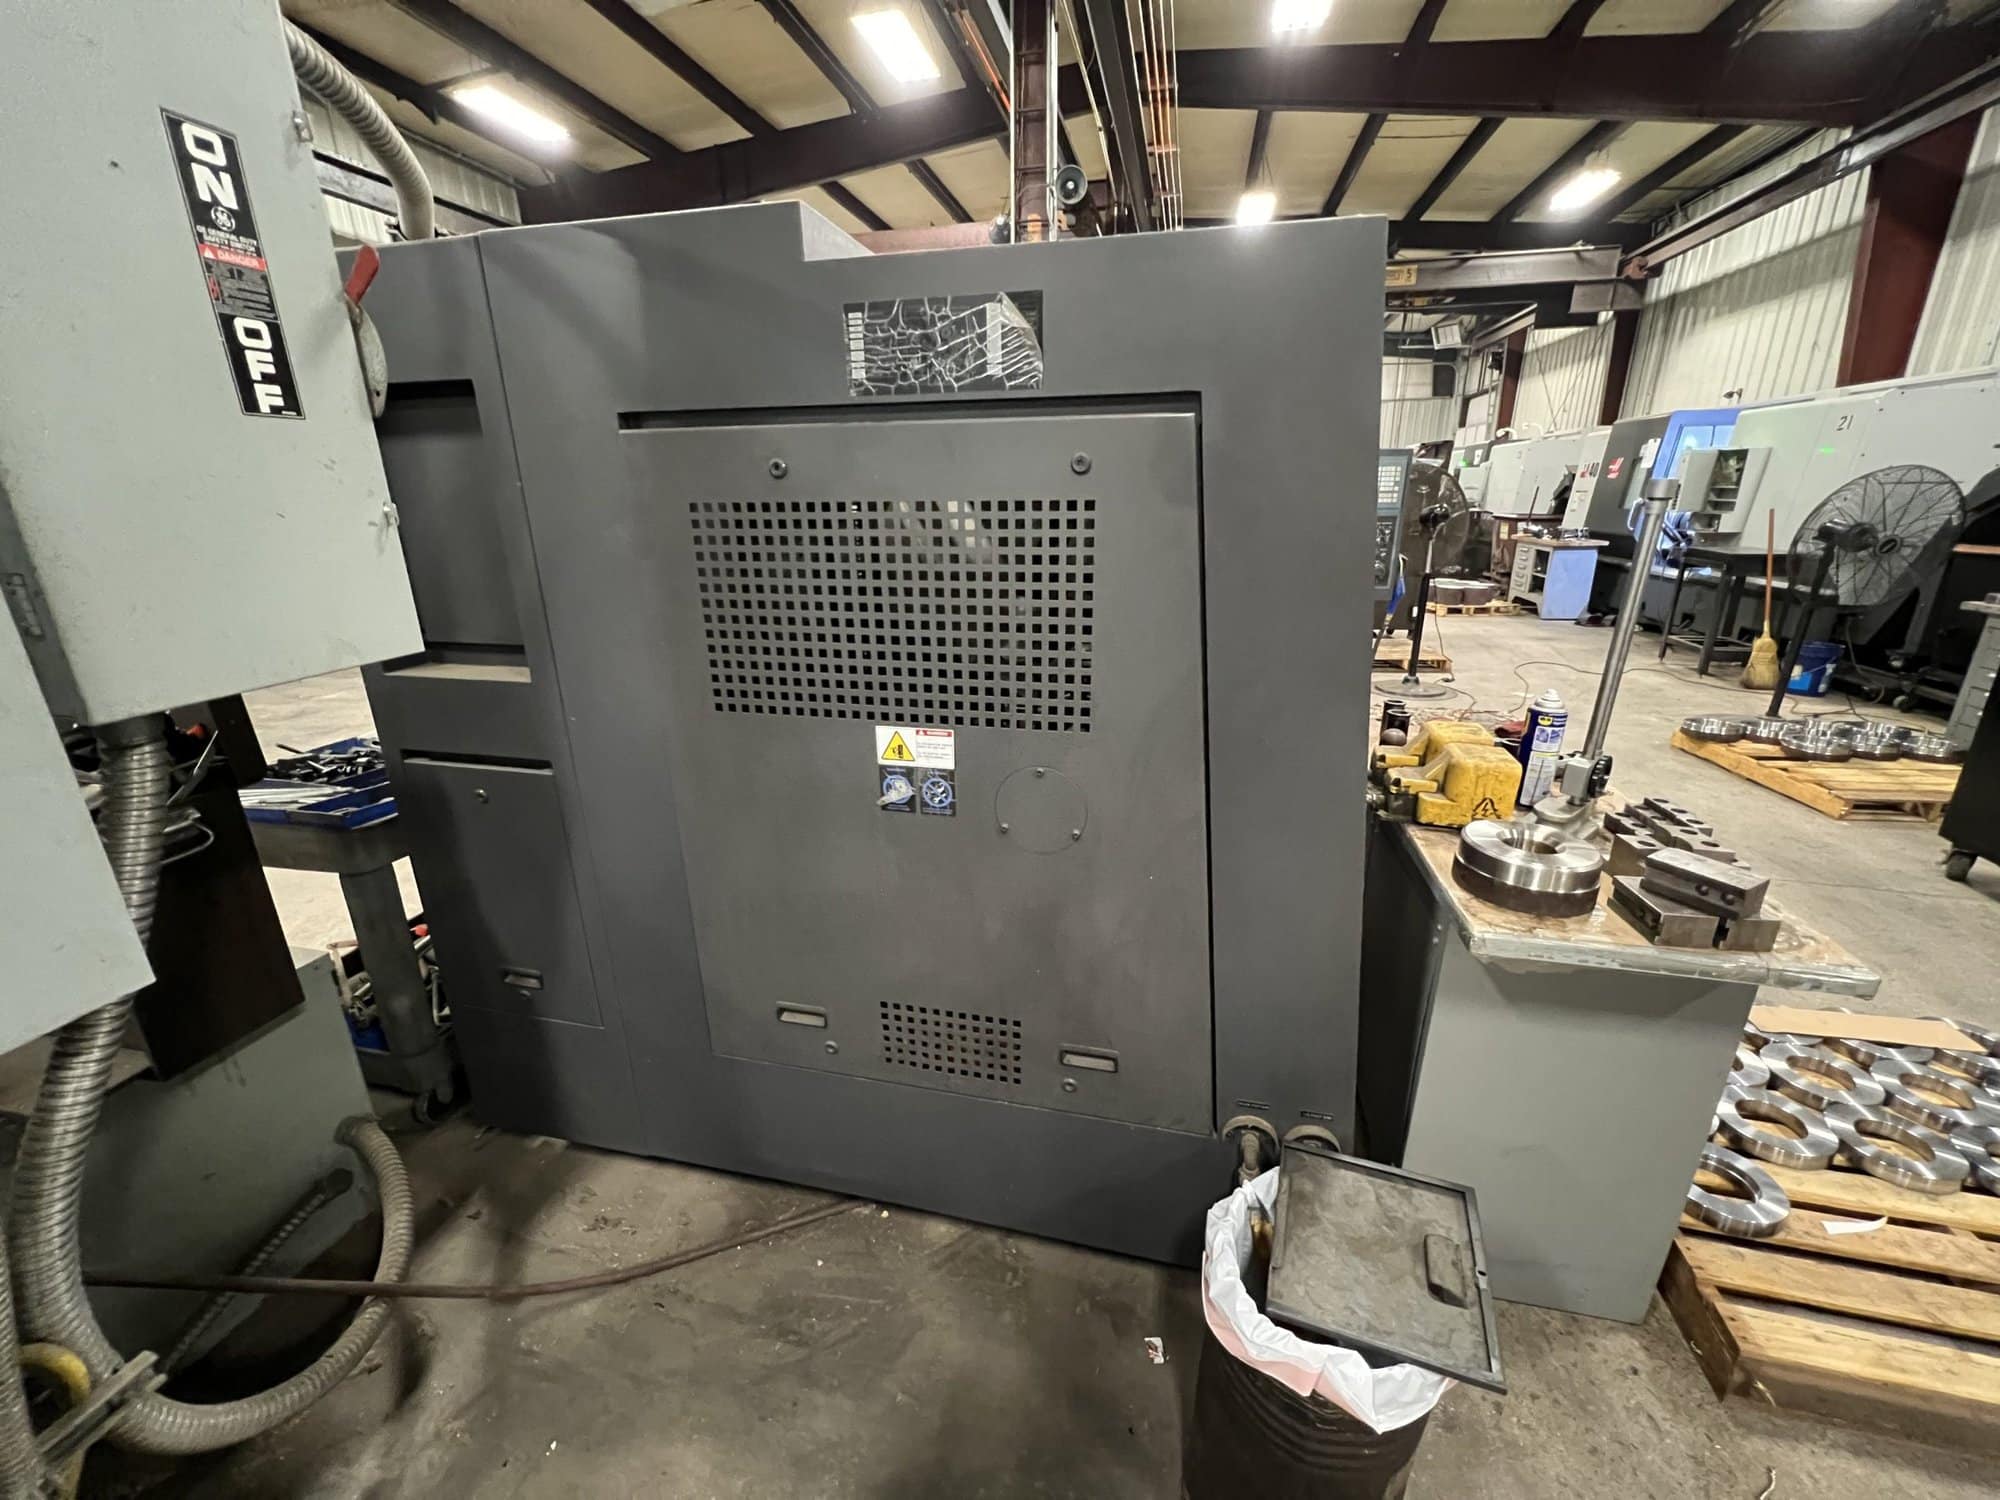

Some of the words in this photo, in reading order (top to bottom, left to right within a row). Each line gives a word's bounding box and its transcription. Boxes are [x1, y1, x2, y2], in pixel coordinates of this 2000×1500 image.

[181, 122, 239, 210] ON
[217, 249, 259, 269] DANGER
[233, 316, 285, 413] OFF
[1836, 414, 1854, 431] 21
